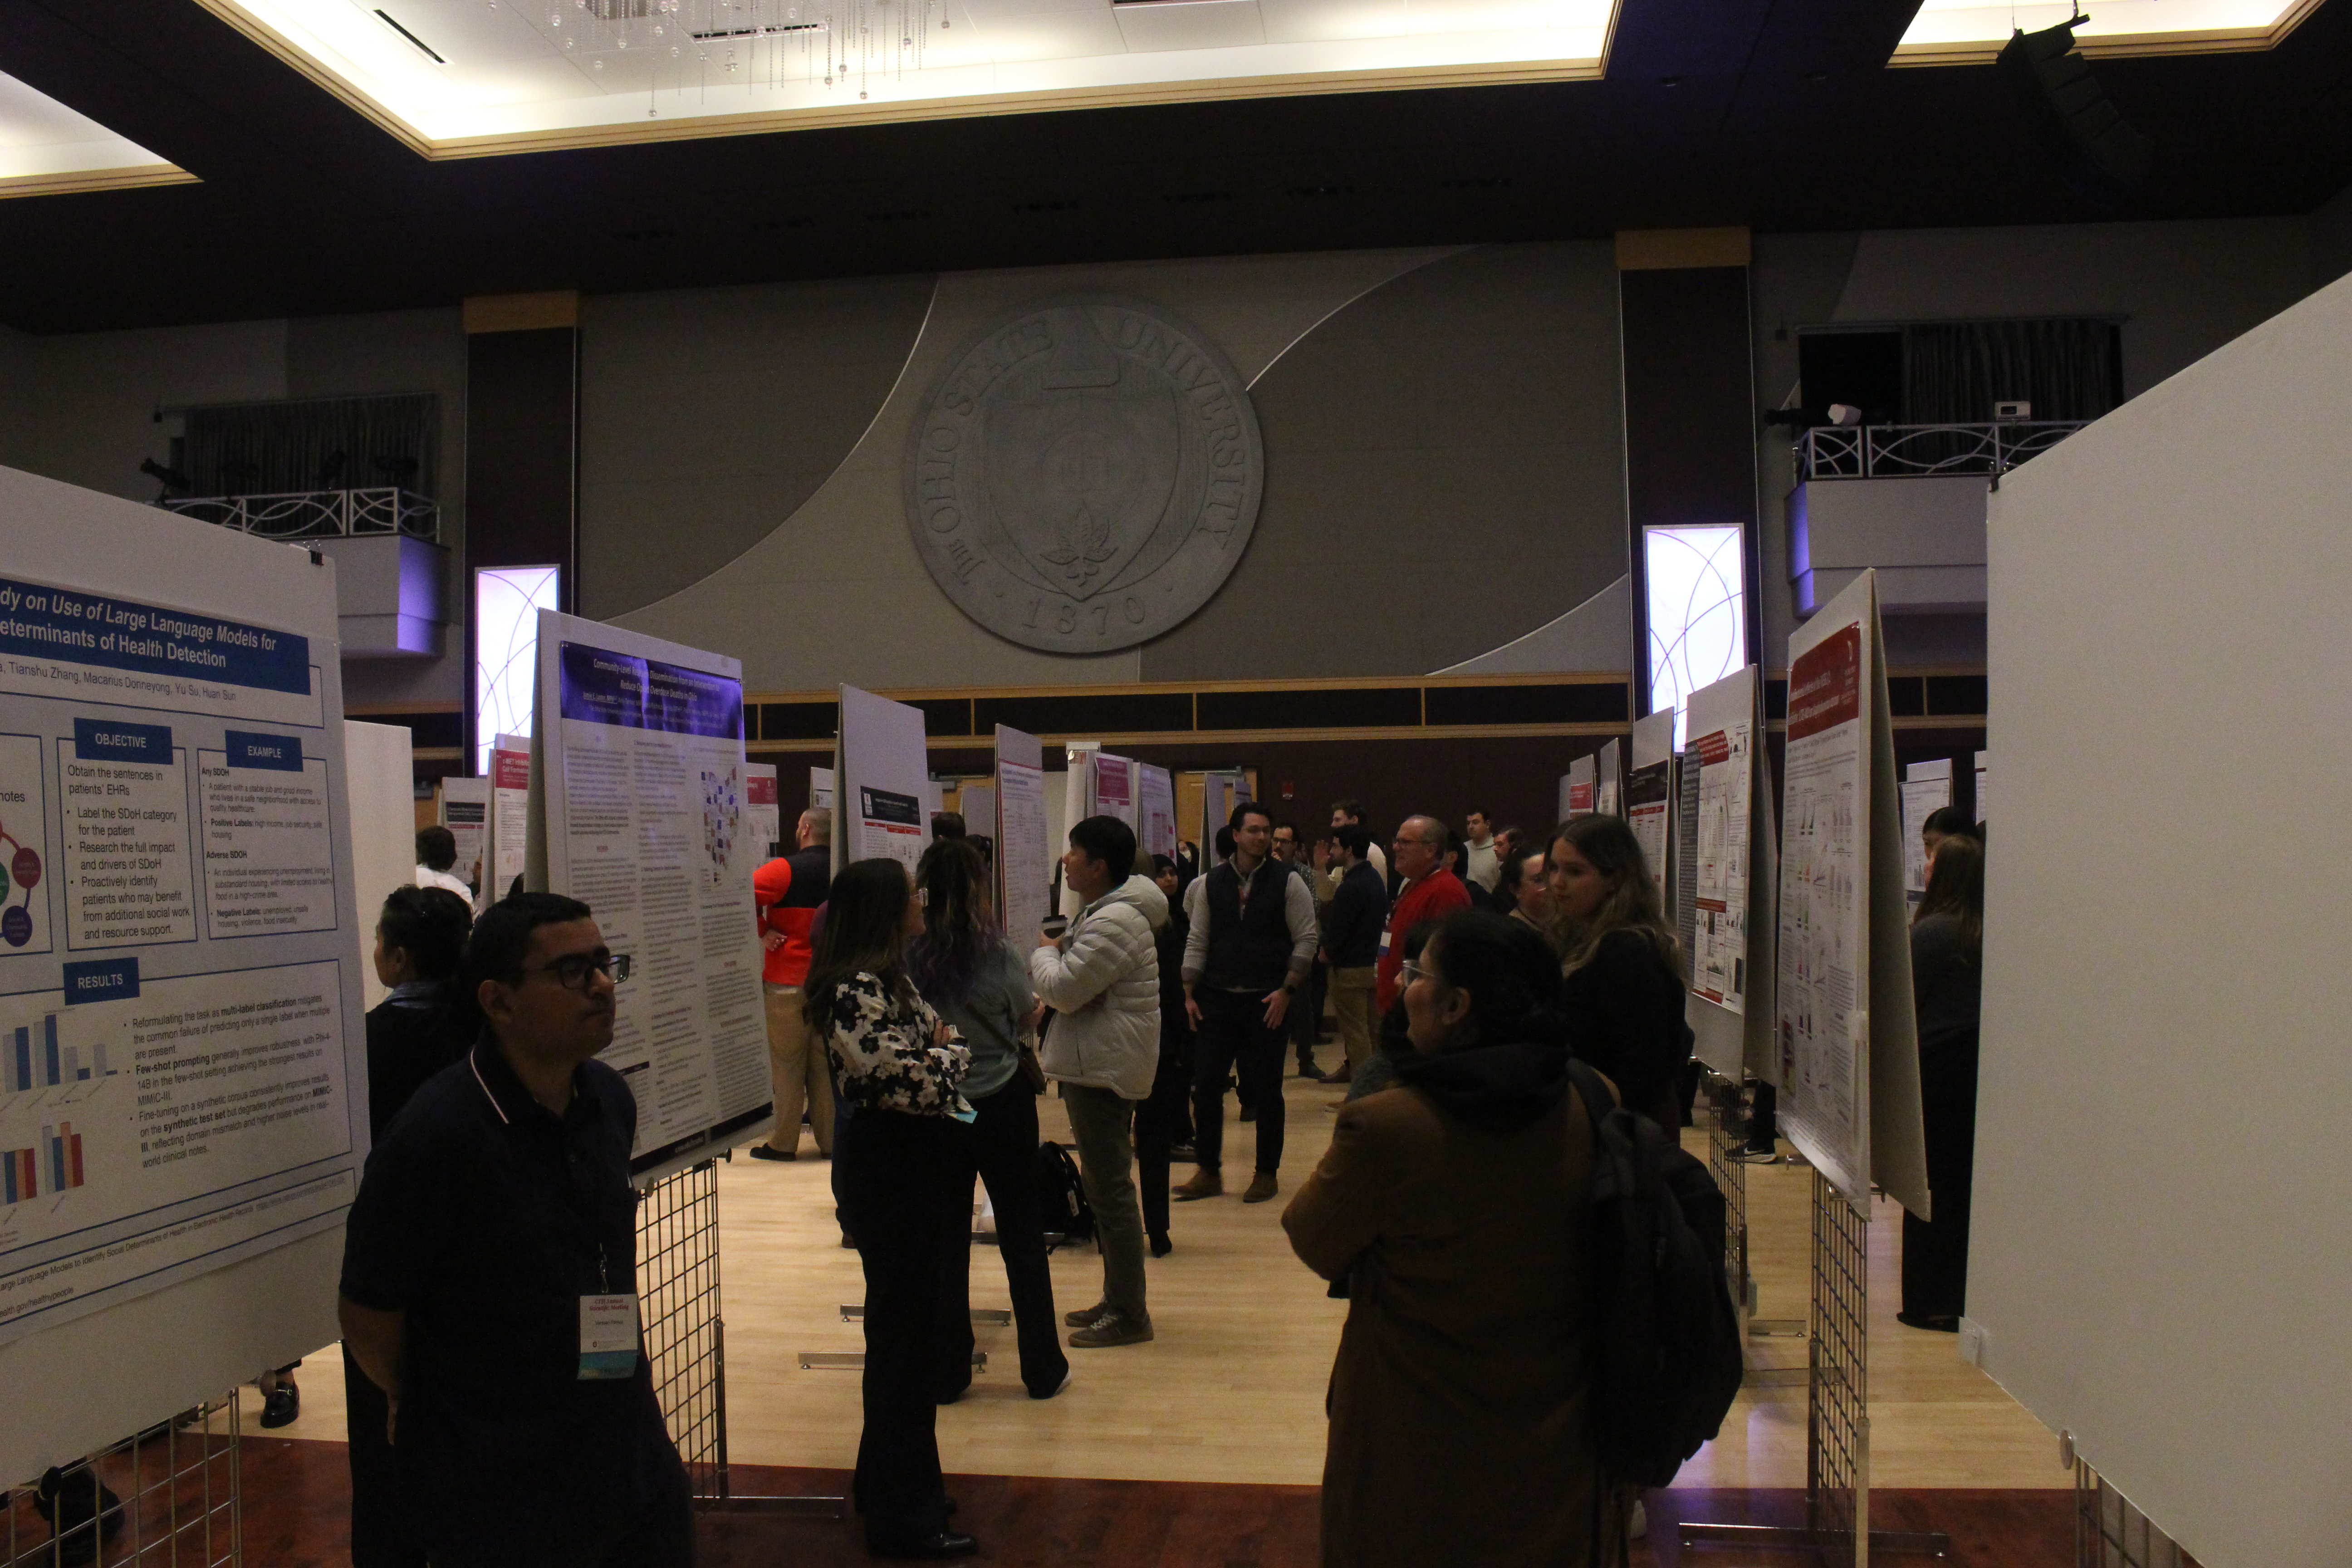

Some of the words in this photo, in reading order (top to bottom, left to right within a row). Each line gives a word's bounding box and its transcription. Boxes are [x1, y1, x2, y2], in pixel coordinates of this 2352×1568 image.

[923, 425, 961, 534] OHIO
[945, 316, 1054, 417] STATE
[1114, 317, 1247, 550] UNIVERSITY
[25, 594, 46, 611] on
[52, 594, 82, 617] Use
[87, 603, 103, 621] of
[106, 605, 147, 631] Large
[151, 612, 213, 642] Language
[216, 625, 258, 648] Models
[261, 634, 277, 651] for
[1022, 597, 1147, 636] 1870
[100, 633, 116, 650] of
[119, 635, 162, 658] Health
[167, 642, 226, 668] Detection
[594, 659, 631, 674] Community-Level
[650, 670, 678, 683] Dissemination
[9, 661, 48, 678] Tianshu
[51, 667, 81, 684] Zhang,
[84, 671, 123, 687] Macarius
[125, 677, 172, 696] Donneyong,
[175, 683, 186, 695] Yu
[188, 685, 201, 697] Su,
[203, 688, 220, 699] Huan
[222, 690, 236, 701] Sun
[621, 680, 637, 691] Reduce
[650, 685, 669, 696] Overdose
[95, 733, 147, 748] OBJECTIVE
[248, 745, 282, 758] EXAMPLE
[1074, 751, 1087, 764] EXI
[68, 764, 95, 777] Obtain
[98, 767, 111, 778] the
[113, 769, 153, 780] sentences
[156, 770, 163, 780] in
[202, 768, 211, 777] Any
[213, 768, 229, 776] SDOH
[107, 784, 130, 796] EHRs
[78, 807, 100, 818] Label
[102, 808, 115, 818] the
[118, 808, 141, 819] SDoH
[143, 810, 176, 823] category
[211, 818, 232, 826] Positive
[78, 824, 91, 835] for
[92, 825, 105, 836] the
[108, 826, 135, 838] patient
[80, 842, 118, 853] Research
[121, 842, 133, 853] the
[135, 841, 147, 852] full
[149, 842, 175, 855] impact
[206, 851, 228, 859] Adverse
[81, 859, 96, 870] and
[99, 859, 127, 870] drivers
[130, 859, 137, 869] of
[139, 859, 161, 869] SDoH
[82, 876, 127, 890] Proactively
[130, 875, 158, 888] identify
[83, 894, 116, 907] patients
[118, 893, 134, 903] who
[137, 893, 153, 904] may
[156, 891, 182, 902] benefit
[83, 911, 103, 922] from
[105, 909, 144, 921] additional
[147, 907, 170, 918] social
[172, 906, 190, 917] work
[217, 908, 241, 919] Negative
[84, 928, 99, 940] and
[102, 927, 138, 938] resource
[141, 925, 173, 938] support.
[78, 974, 123, 989] RESULTS
[132, 1014, 183, 1029] Reformulating
[184, 1010, 195, 1021] the
[197, 1009, 211, 1020] task
[221, 1003, 255, 1016] multi-label
[257, 998, 296, 1011] classification
[134, 1034, 145, 1044] the
[147, 1029, 178, 1042] common
[180, 1025, 200, 1037] failure
[202, 1024, 209, 1034] of
[210, 1020, 240, 1036] predicting
[241, 1019, 254, 1030] only
[261, 1014, 278, 1025] single
[279, 1011, 293, 1022] label
[294, 1009, 309, 1019] when
[135, 1051, 146, 1060] are
[148, 1045, 177, 1058] present.
[136, 1061, 171, 1075] Few-shot
[173, 1055, 210, 1070] prompting
[212, 1049, 239, 1064] generally
[241, 1044, 268, 1056] improves
[138, 1079, 151, 1090] 14B
[152, 1078, 159, 1087] in
[161, 1076, 172, 1087] the
[175, 1069, 203, 1083] few-shot
[205, 1065, 226, 1077] setting
[228, 1061, 257, 1073] achieving
[258, 1058, 267, 1067] the
[269, 1054, 295, 1065] strongest
[296, 1049, 314, 1060] results
[315, 1048, 323, 1056] on
[138, 1091, 172, 1106] MIMIC-III.
[139, 1106, 179, 1122] Fine-tuning
[181, 1104, 189, 1113] on
[197, 1094, 226, 1110] synthetic
[228, 1092, 248, 1102] corpus
[250, 1083, 284, 1098] consistently
[285, 1078, 310, 1089] improves
[311, 1073, 329, 1084] results
[140, 1128, 149, 1137] on
[151, 1125, 162, 1135] the
[164, 1117, 198, 1133] synthetic
[200, 1113, 213, 1123] test
[215, 1110, 226, 1120] set
[227, 1108, 237, 1117] but
[238, 1102, 267, 1115] degrades
[268, 1093, 303, 1110] performance
[152, 1135, 184, 1150] reflecting
[186, 1129, 211, 1142] domain
[212, 1121, 241, 1135] mismatch
[244, 1117, 255, 1128] and
[257, 1114, 275, 1126] higher
[276, 1111, 292, 1120] noise
[142, 1155, 161, 1168] world
[162, 1149, 187, 1163] clinical
[17, 1270, 49, 1285] Language
[50, 1263, 74, 1274] Models
[83, 1252, 105, 1264] Identify
[107, 1246, 125, 1257] Social
[126, 1234, 162, 1252] Determinants
[169, 1227, 187, 1237] Health
